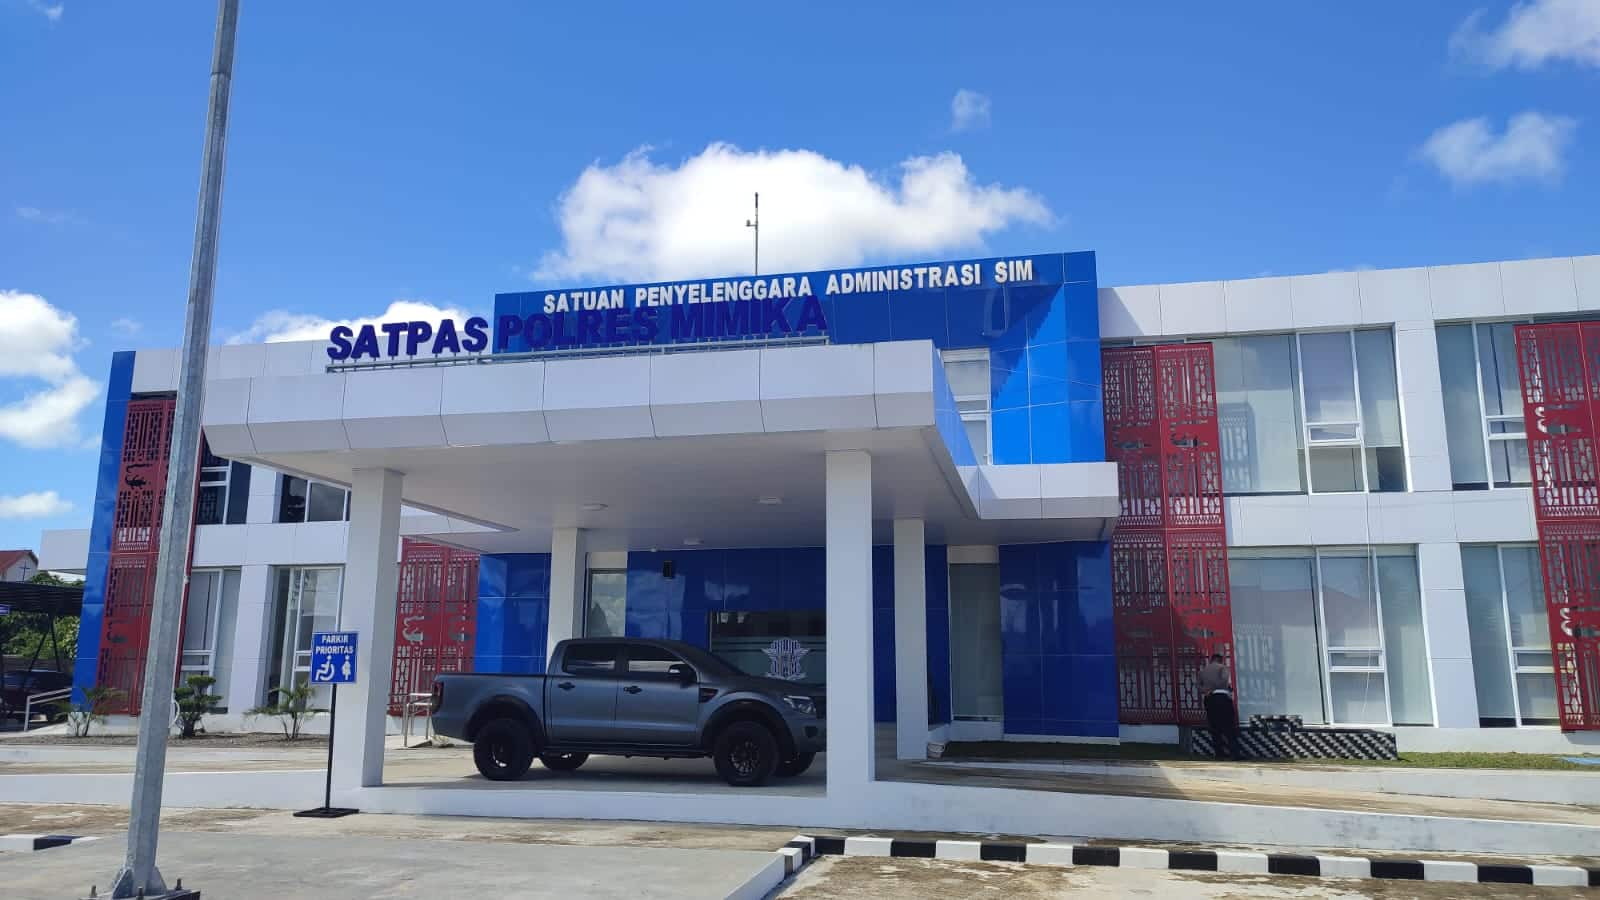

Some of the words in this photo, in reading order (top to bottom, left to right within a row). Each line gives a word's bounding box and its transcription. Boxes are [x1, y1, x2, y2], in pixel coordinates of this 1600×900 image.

[543, 289, 625, 313] SATUAN
[635, 276, 812, 306] PENYELENGGARA
[826, 263, 981, 295] ADMINISTRASI
[994, 260, 1033, 283] SIM
[327, 317, 488, 360] SATPAS
[497, 307, 659, 350] POLRES
[671, 294, 828, 340] MIMIKA
[315, 645, 354, 654] PRIORITAS
[321, 634, 349, 643] PARKIR
